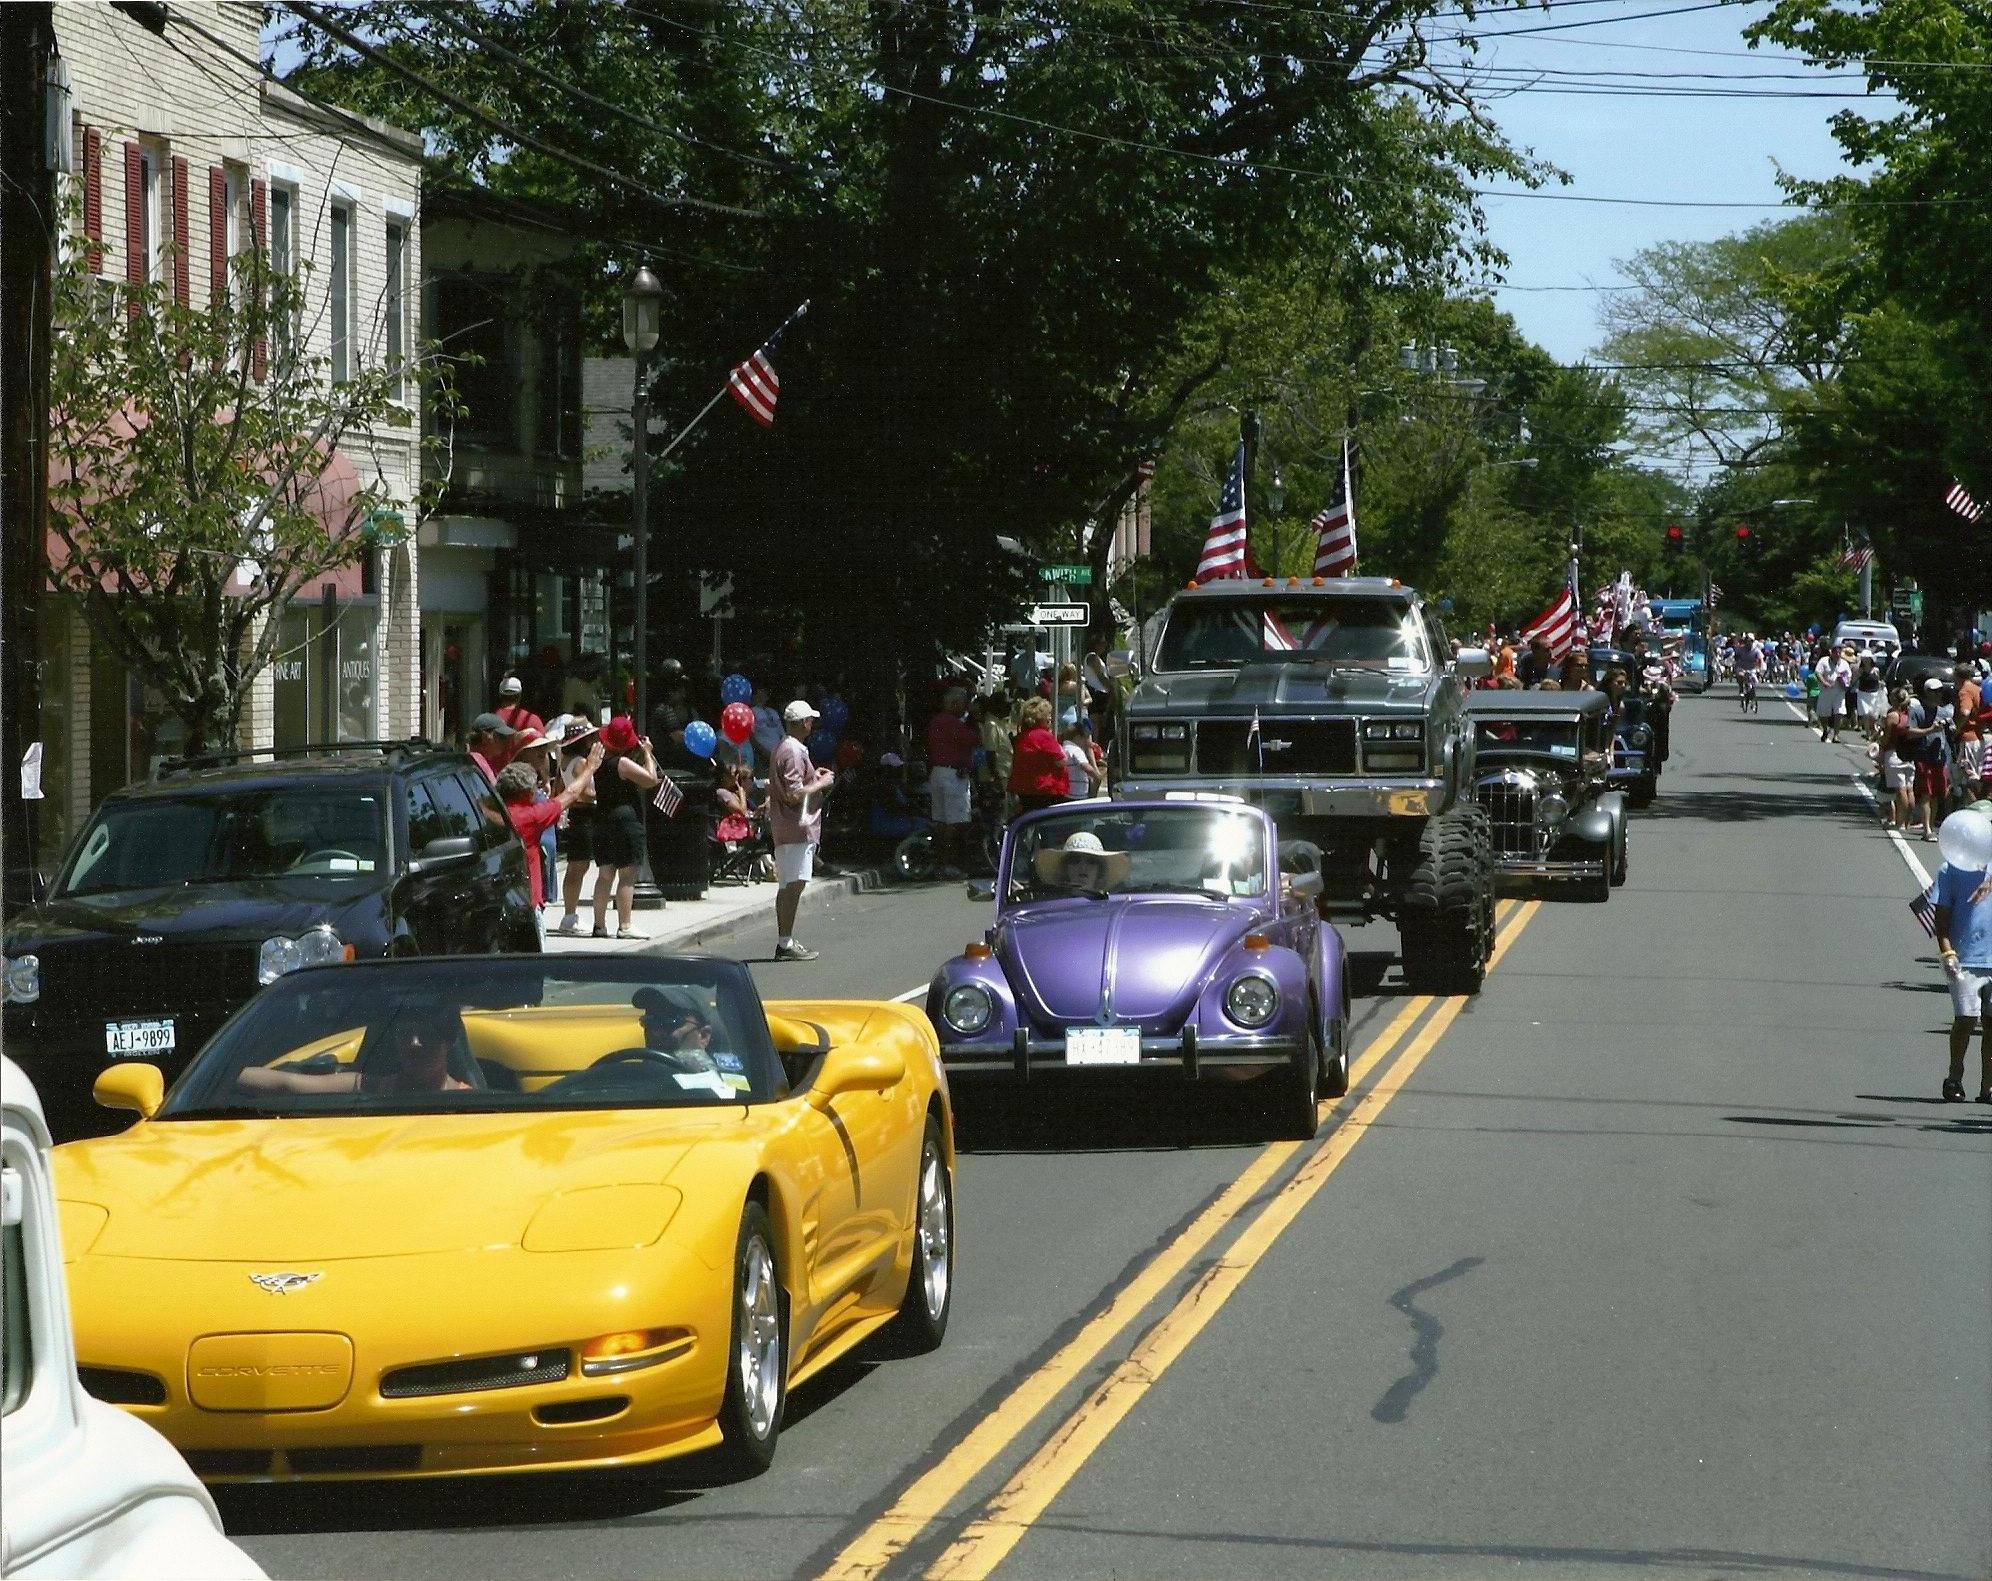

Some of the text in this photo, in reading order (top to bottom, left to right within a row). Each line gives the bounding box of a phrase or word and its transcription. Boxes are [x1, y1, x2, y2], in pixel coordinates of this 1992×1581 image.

[1041, 610, 1081, 619] ONE WAY
[290, 662, 302, 680] ART
[342, 661, 370, 680] ANTIQUES
[131, 936, 163, 945] Jeep
[197, 1364, 340, 1377] CORVETTE
